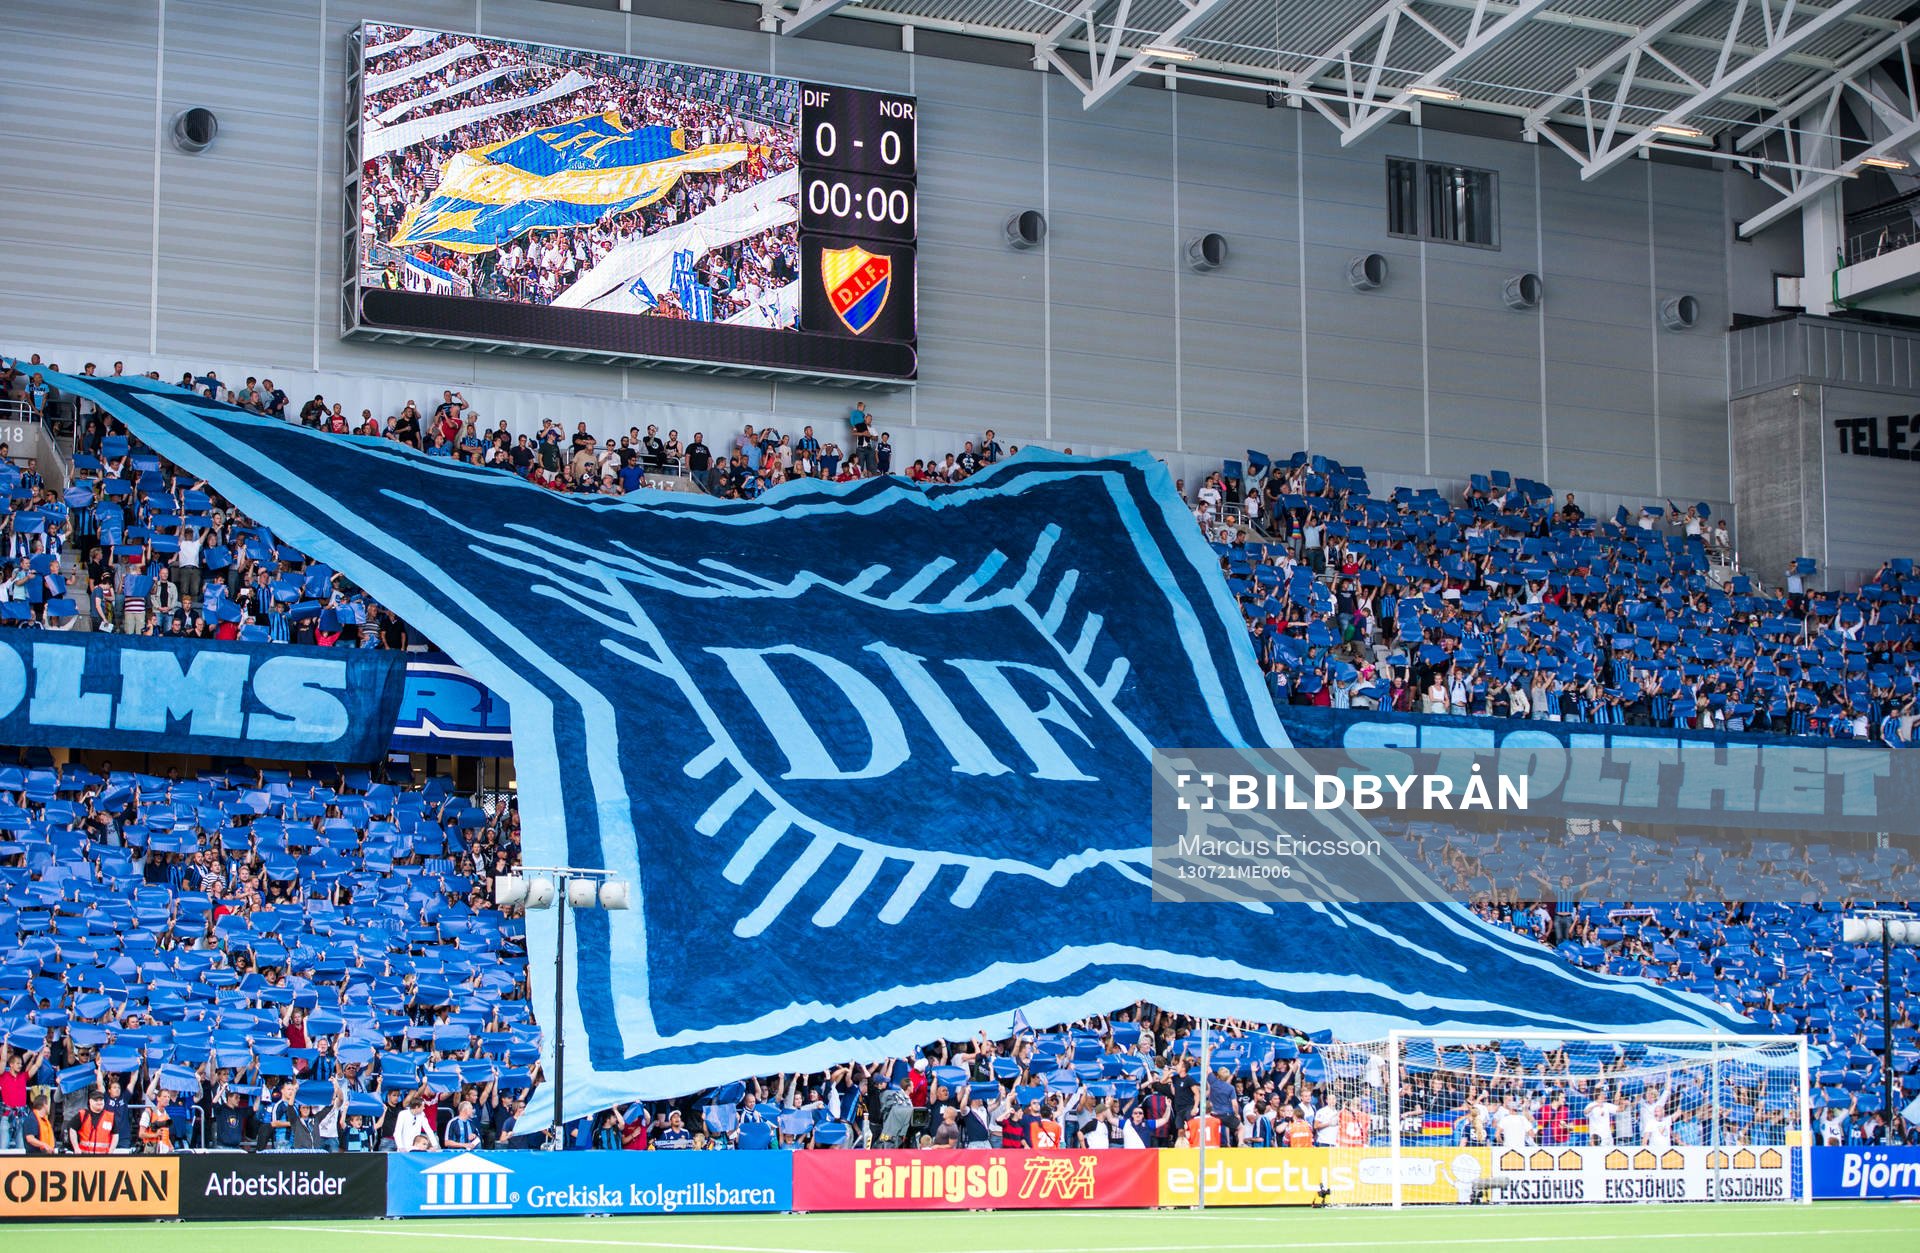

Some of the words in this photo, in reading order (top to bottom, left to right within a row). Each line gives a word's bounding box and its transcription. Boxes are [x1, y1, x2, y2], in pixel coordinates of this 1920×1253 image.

[804, 90, 830, 107] DIF
[880, 100, 914, 119] NOR
[816, 122, 837, 157] 0
[880, 131, 901, 165] 0
[808, 180, 909, 224] 00:00
[837, 264, 885, 305] D.I.F.
[0, 427, 23, 442] 18
[702, 641, 1100, 782] DIF
[1340, 721, 1890, 817] STOLTHET
[205, 1171, 347, 1197] Arbetskläder
[855, 1157, 1008, 1202] Färingsö
[1018, 1156, 1098, 1199] TRÄ
[1167, 1159, 1355, 1192] eductus
[1605, 1174, 1686, 1198] EKSJÖHUS
[1841, 1151, 1920, 1197] Björn
[527, 1182, 623, 1208] Grekiska
[629, 1182, 775, 1212] kolgrillsbaren
